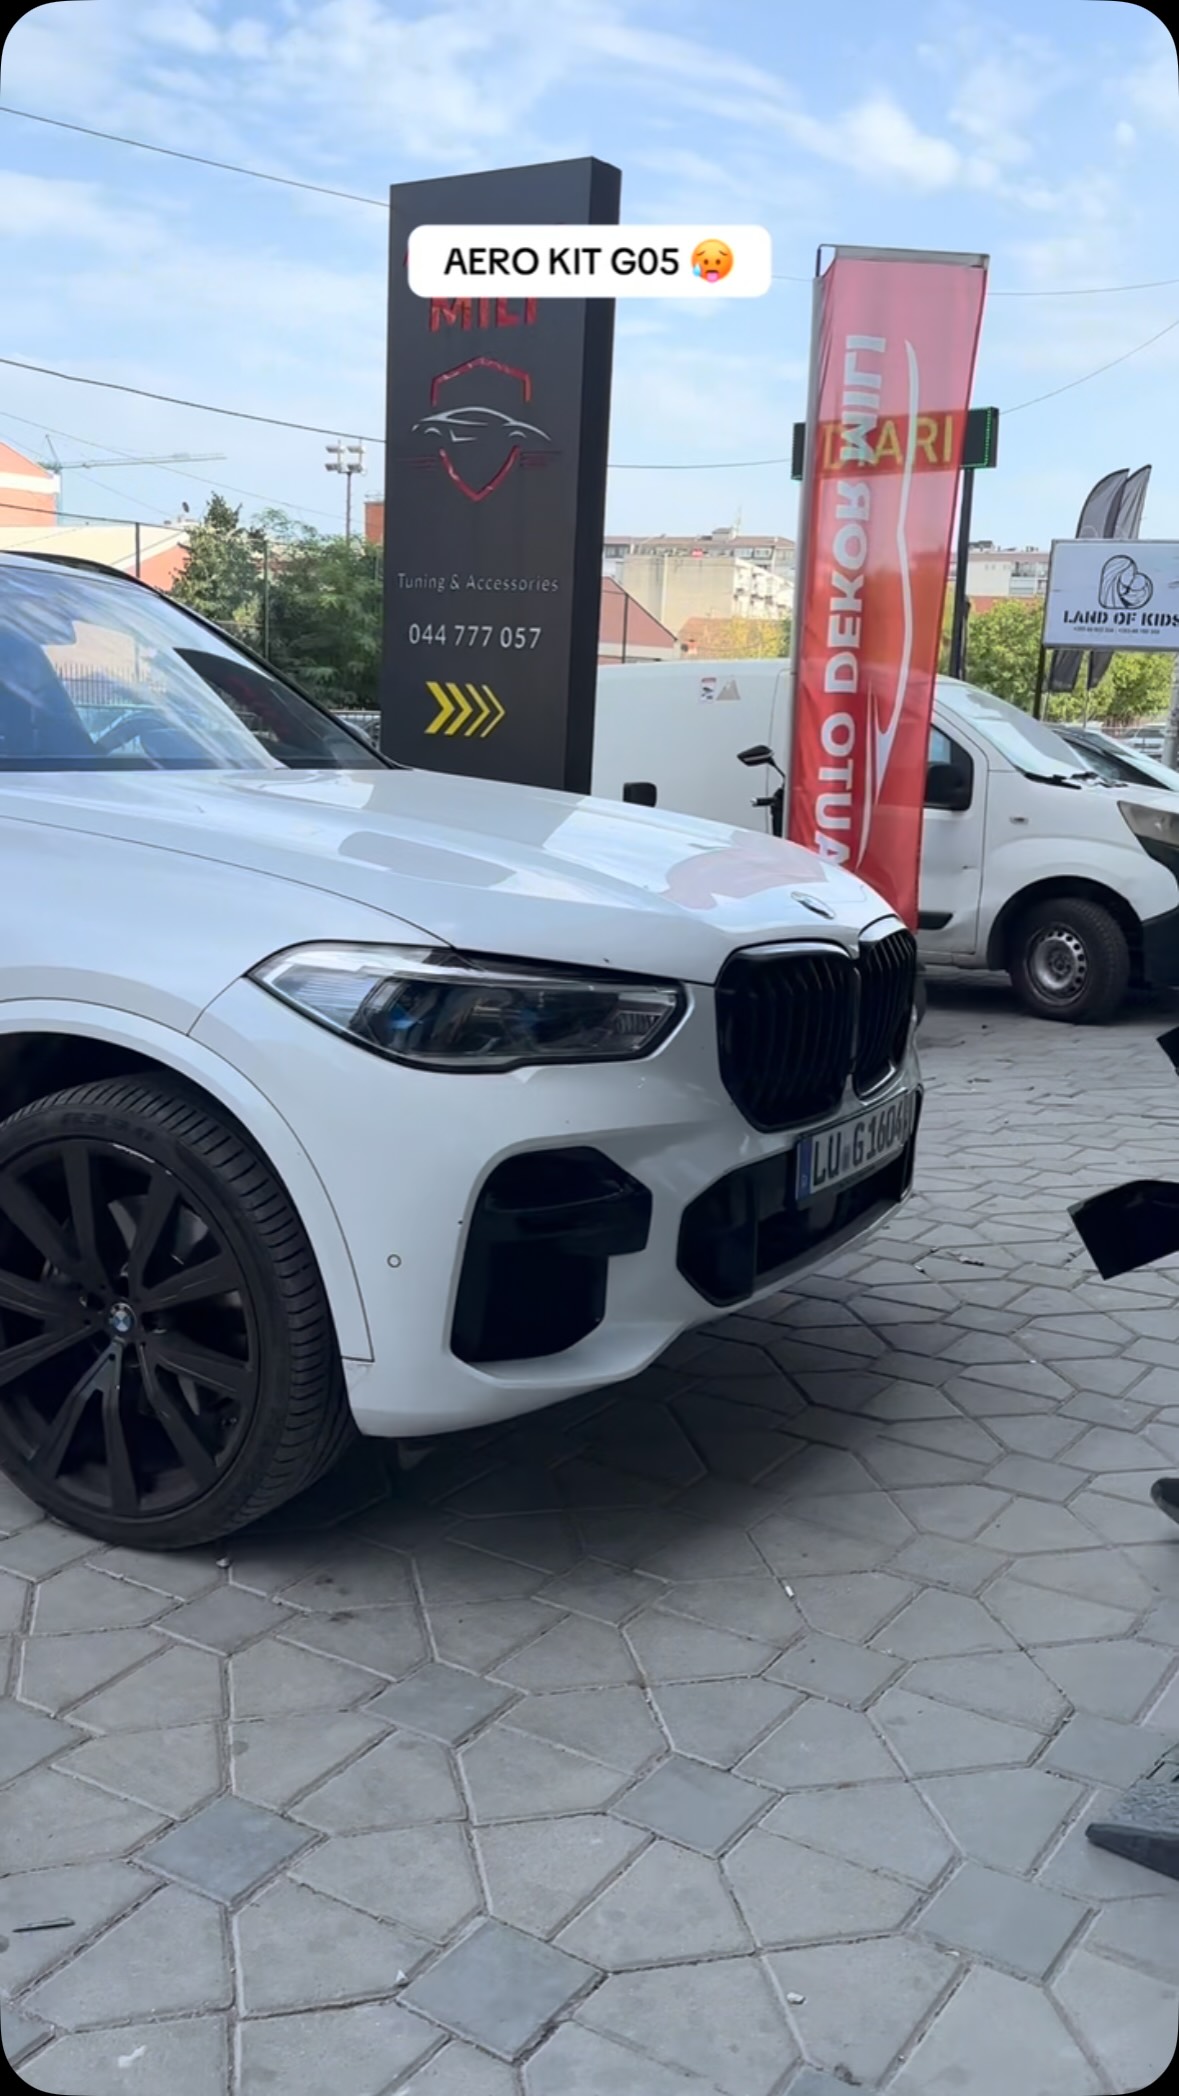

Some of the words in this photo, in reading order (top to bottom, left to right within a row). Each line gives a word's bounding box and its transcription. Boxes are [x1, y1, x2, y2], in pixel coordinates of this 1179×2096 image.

[398, 572, 446, 593] Tuning
[450, 574, 460, 590] &
[466, 574, 559, 592] Accessories
[1063, 609, 1109, 624] LAND
[1113, 611, 1137, 626] OF
[408, 623, 446, 645] 044
[454, 625, 493, 647] 777
[500, 626, 542, 649] 057
[813, 1131, 841, 1187] LU
